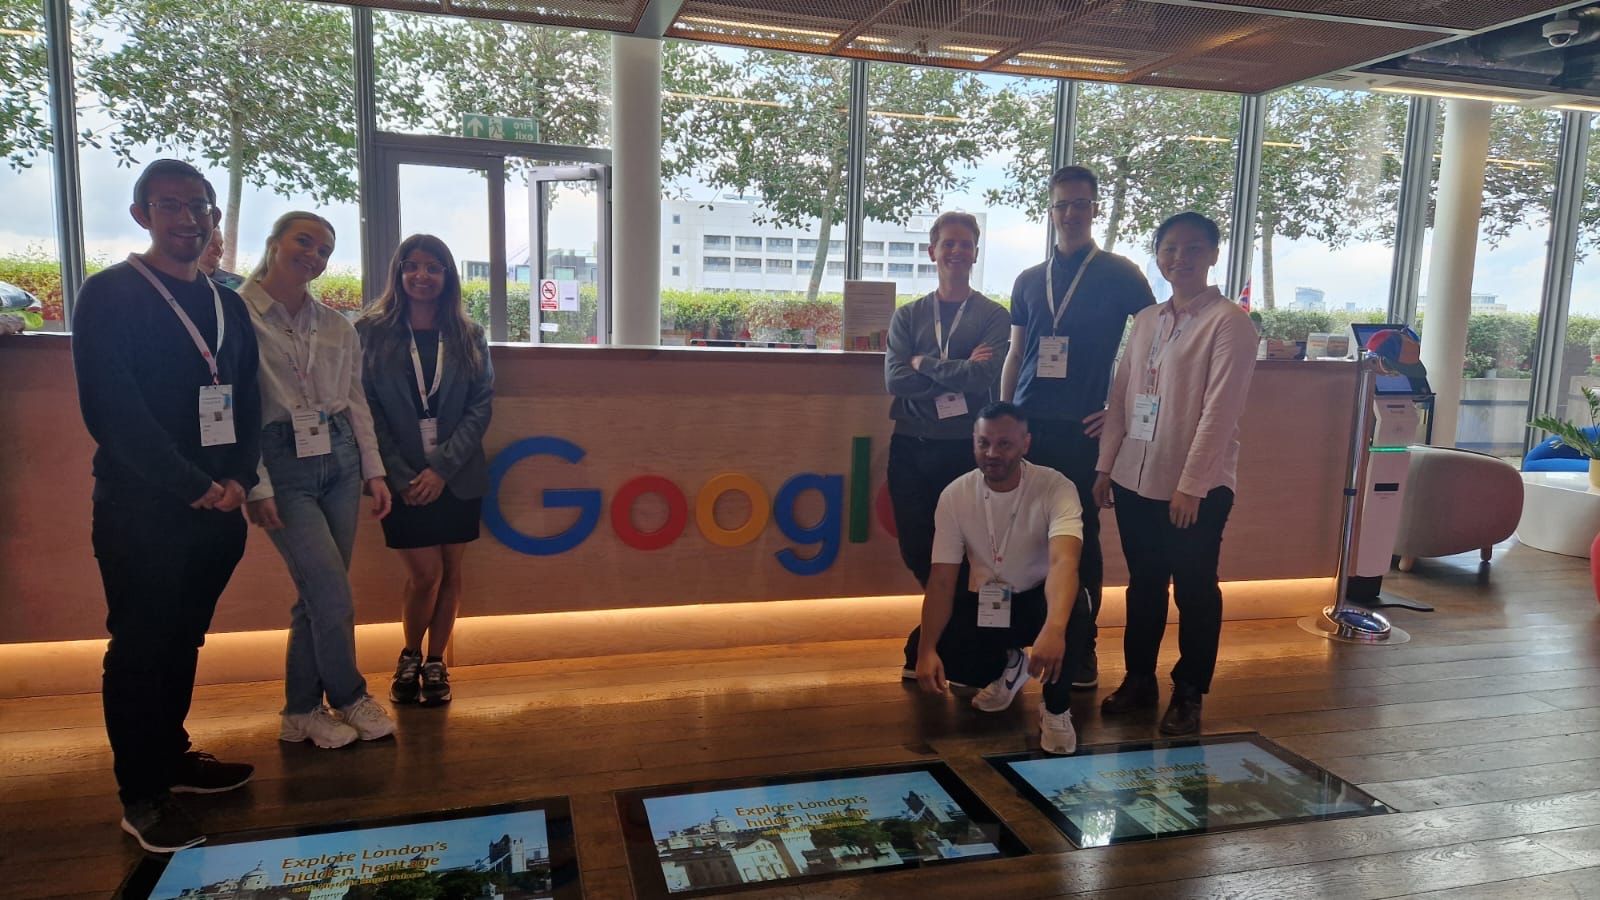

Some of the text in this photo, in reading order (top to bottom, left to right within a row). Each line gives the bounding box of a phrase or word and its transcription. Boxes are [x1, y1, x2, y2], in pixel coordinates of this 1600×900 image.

[481, 436, 899, 576] Googl
[735, 796, 868, 817] Explore London's
[746, 814, 802, 827] hidden
[281, 842, 448, 869] Explore London's
[284, 867, 354, 883] hidden
[361, 857, 440, 873] heritage
